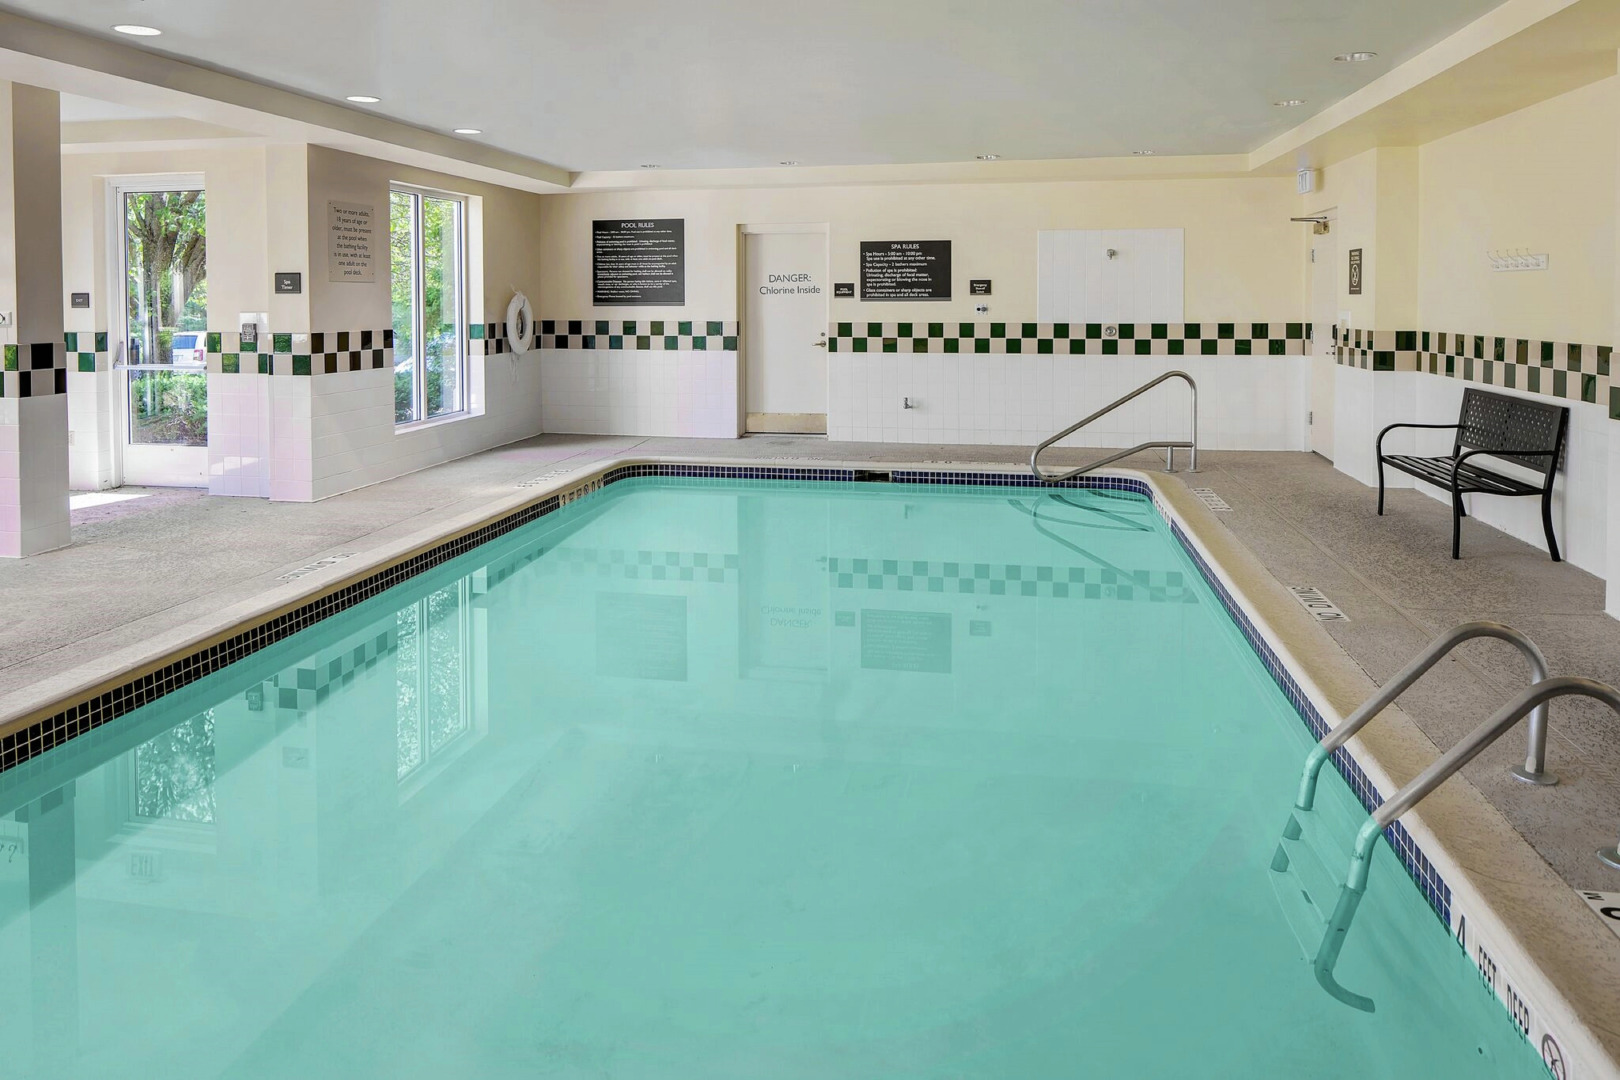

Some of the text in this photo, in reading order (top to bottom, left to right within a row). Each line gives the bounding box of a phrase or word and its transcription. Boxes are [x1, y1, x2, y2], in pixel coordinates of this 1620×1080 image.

[768, 274, 811, 283] DANGER:
[760, 286, 821, 294] Chlorine Inside
